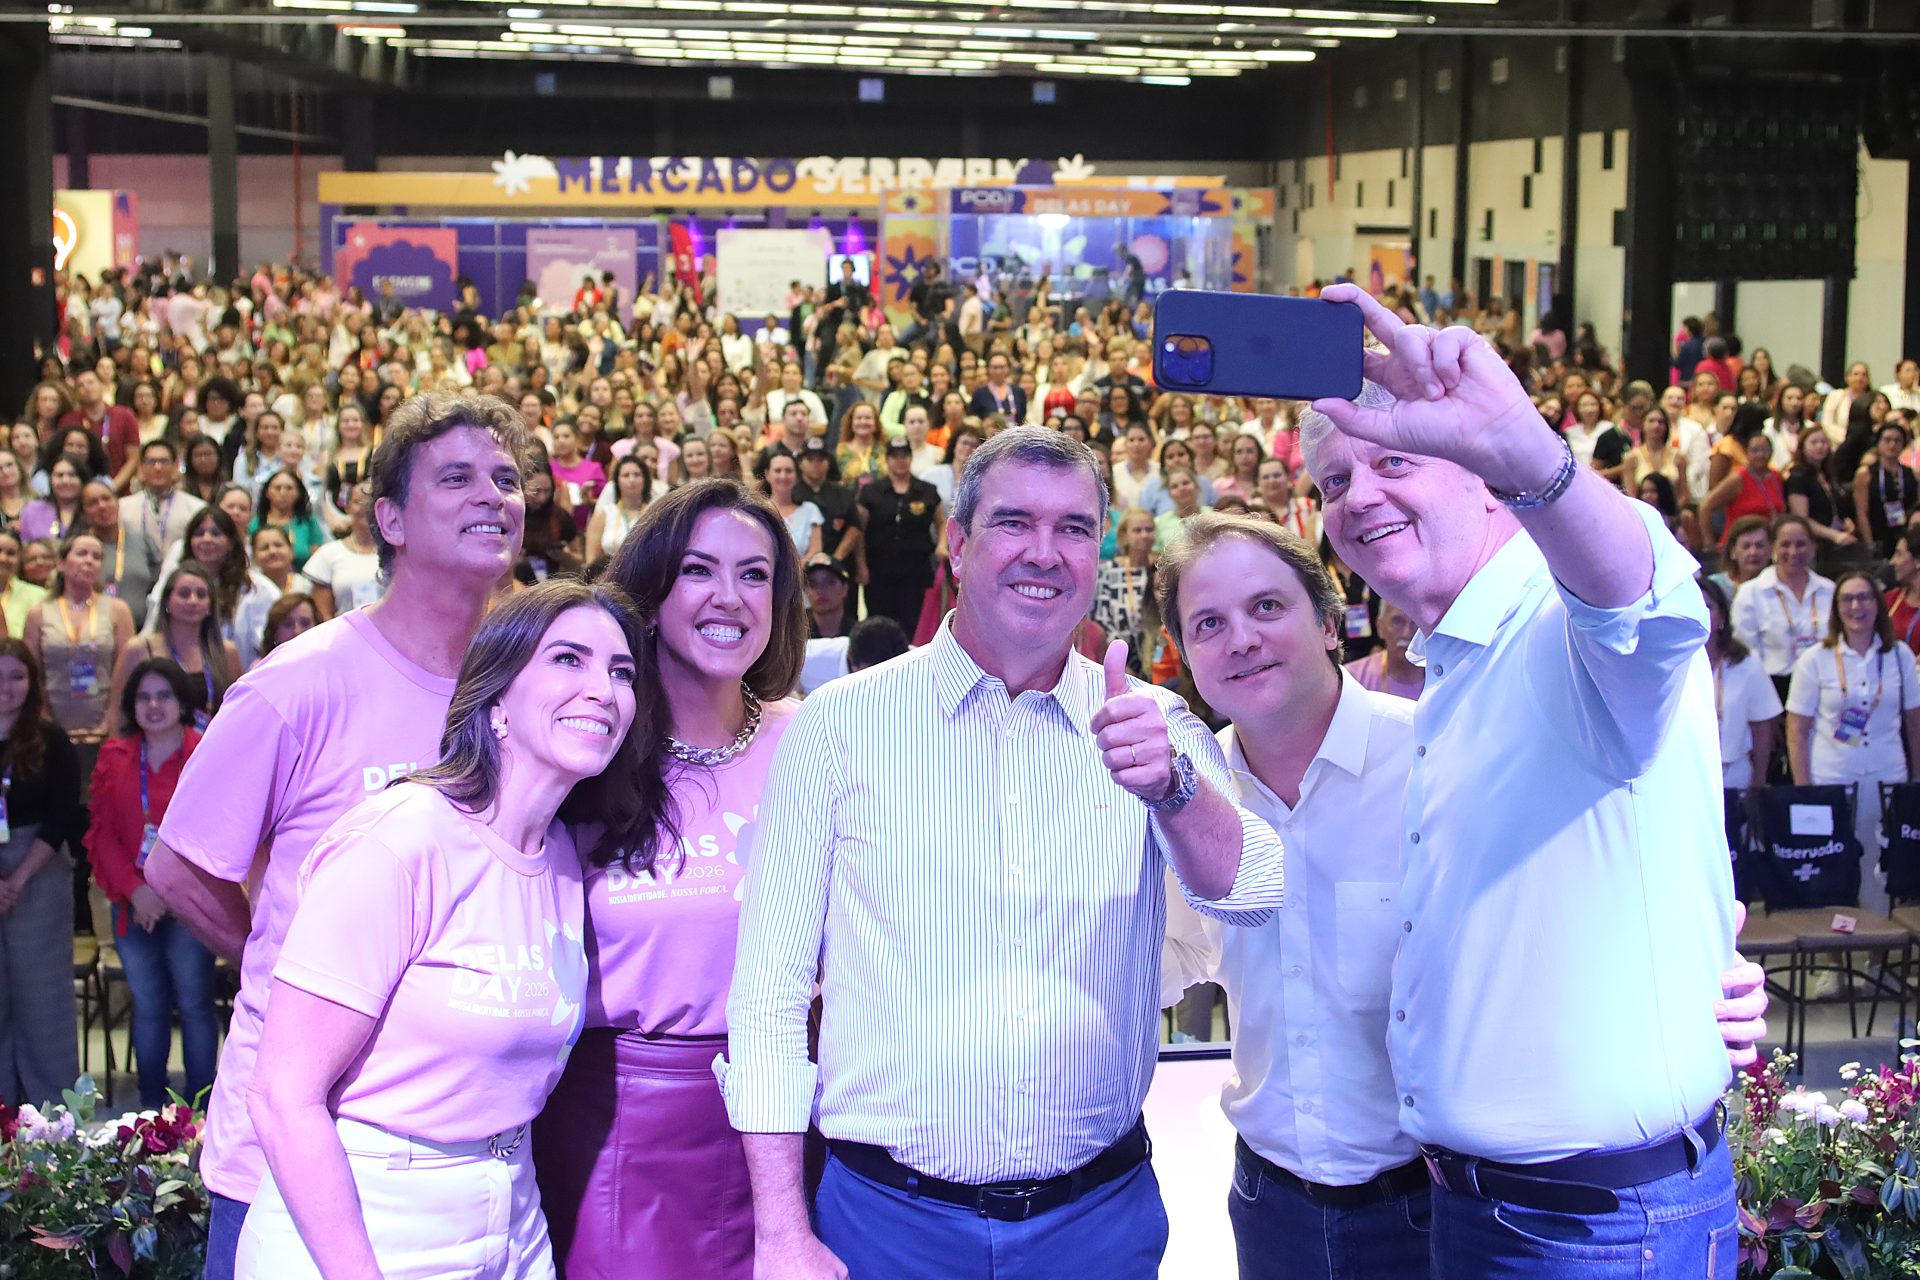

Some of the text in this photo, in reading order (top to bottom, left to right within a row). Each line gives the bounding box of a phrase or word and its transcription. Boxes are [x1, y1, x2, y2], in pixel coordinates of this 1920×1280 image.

[558, 156, 796, 193] MERCADO
[1095, 199, 1133, 214] DAY
[606, 863, 725, 892] DAY 2026
[670, 887, 698, 898] NOSSA
[450, 944, 545, 971] DELAS
[451, 969, 549, 1003] DAY 2026
